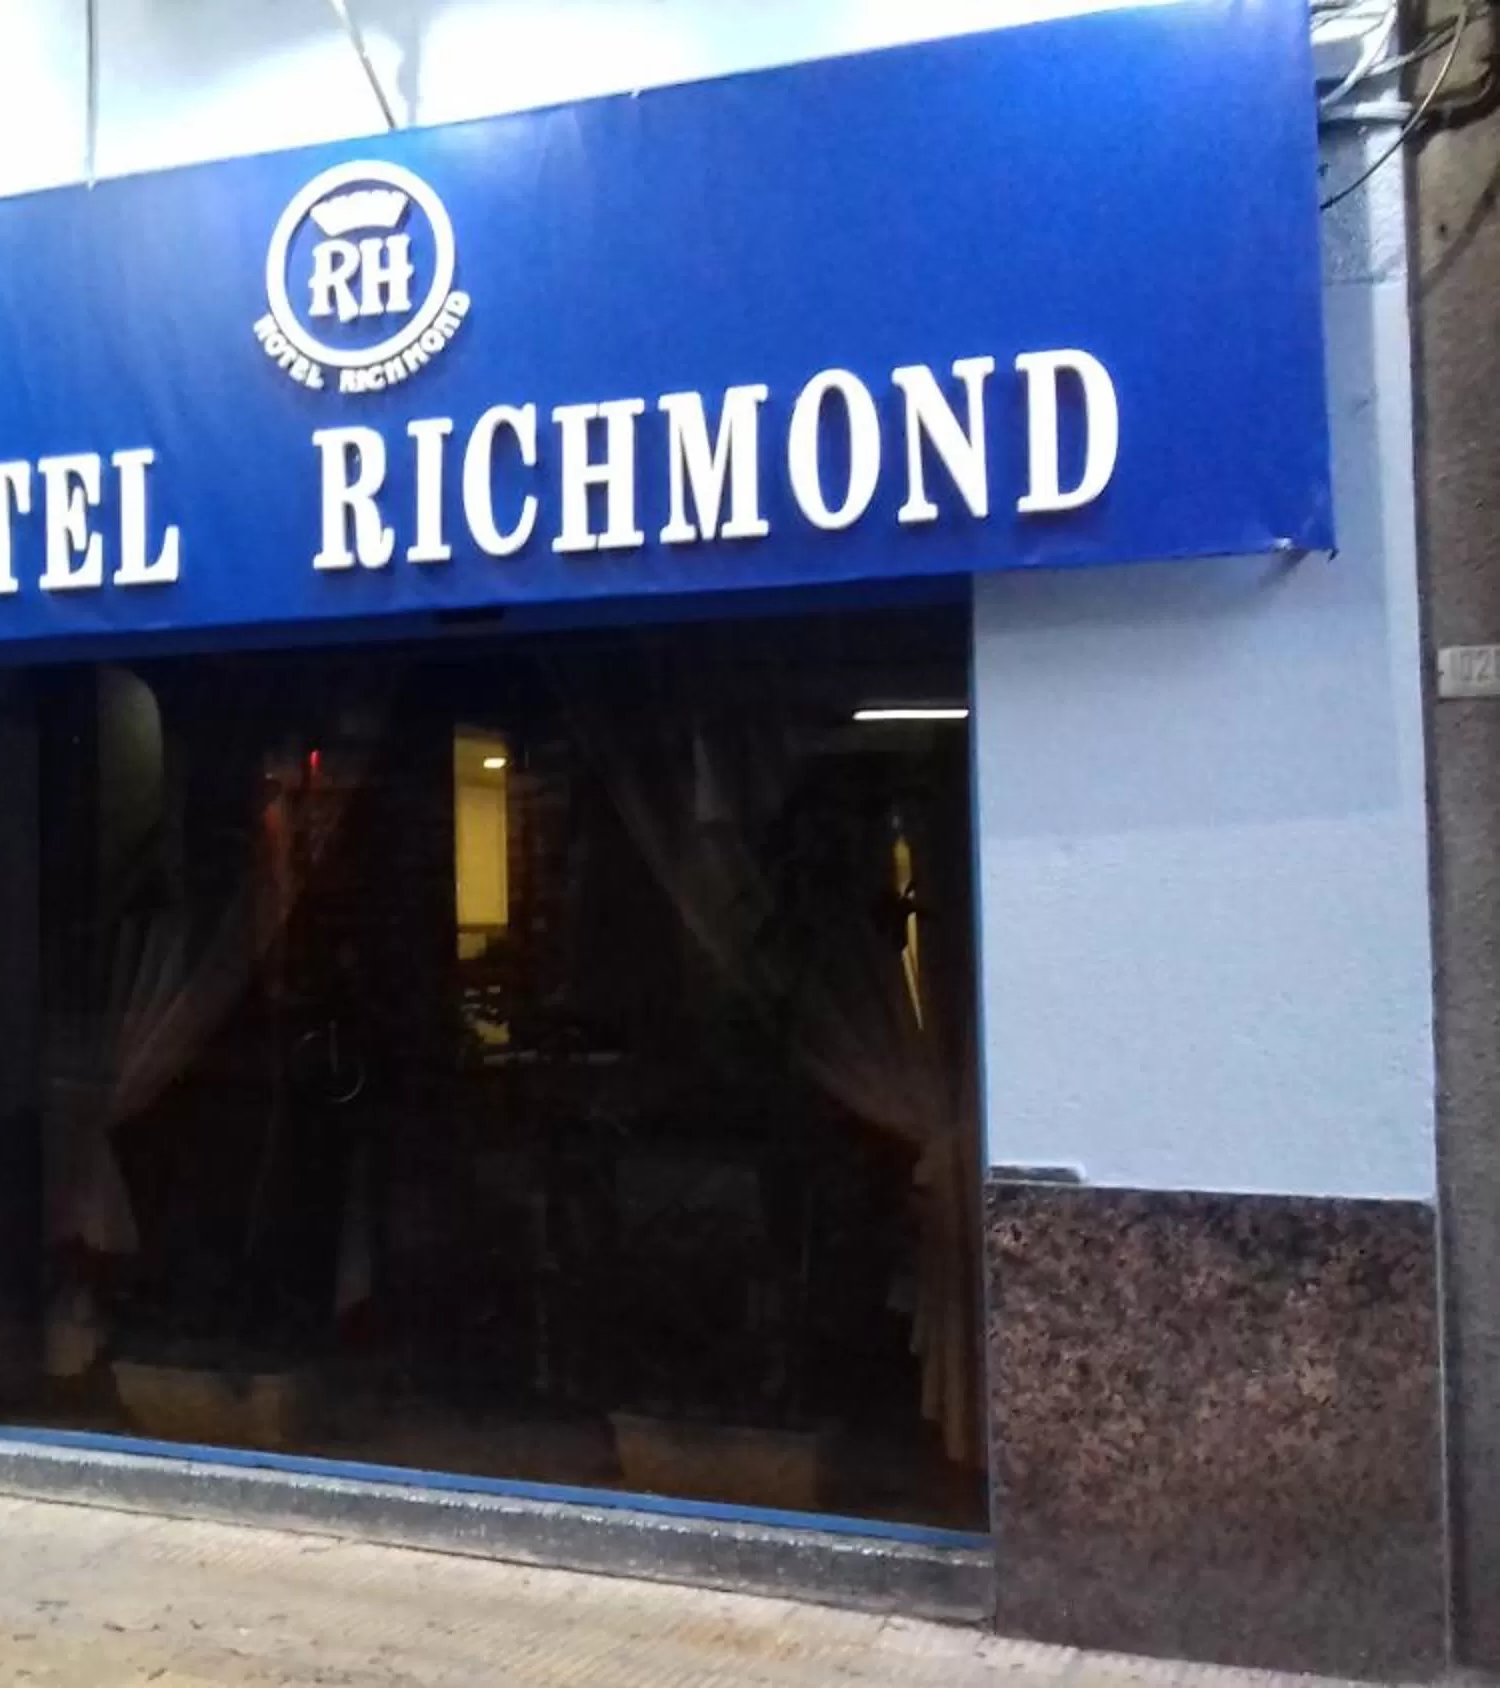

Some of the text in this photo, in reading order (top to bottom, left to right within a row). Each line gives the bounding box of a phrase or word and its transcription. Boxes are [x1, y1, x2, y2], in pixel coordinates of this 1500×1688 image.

[308, 232, 414, 324] RH
[253, 313, 325, 389] HOTEL
[311, 347, 1120, 571] RICHMOND
